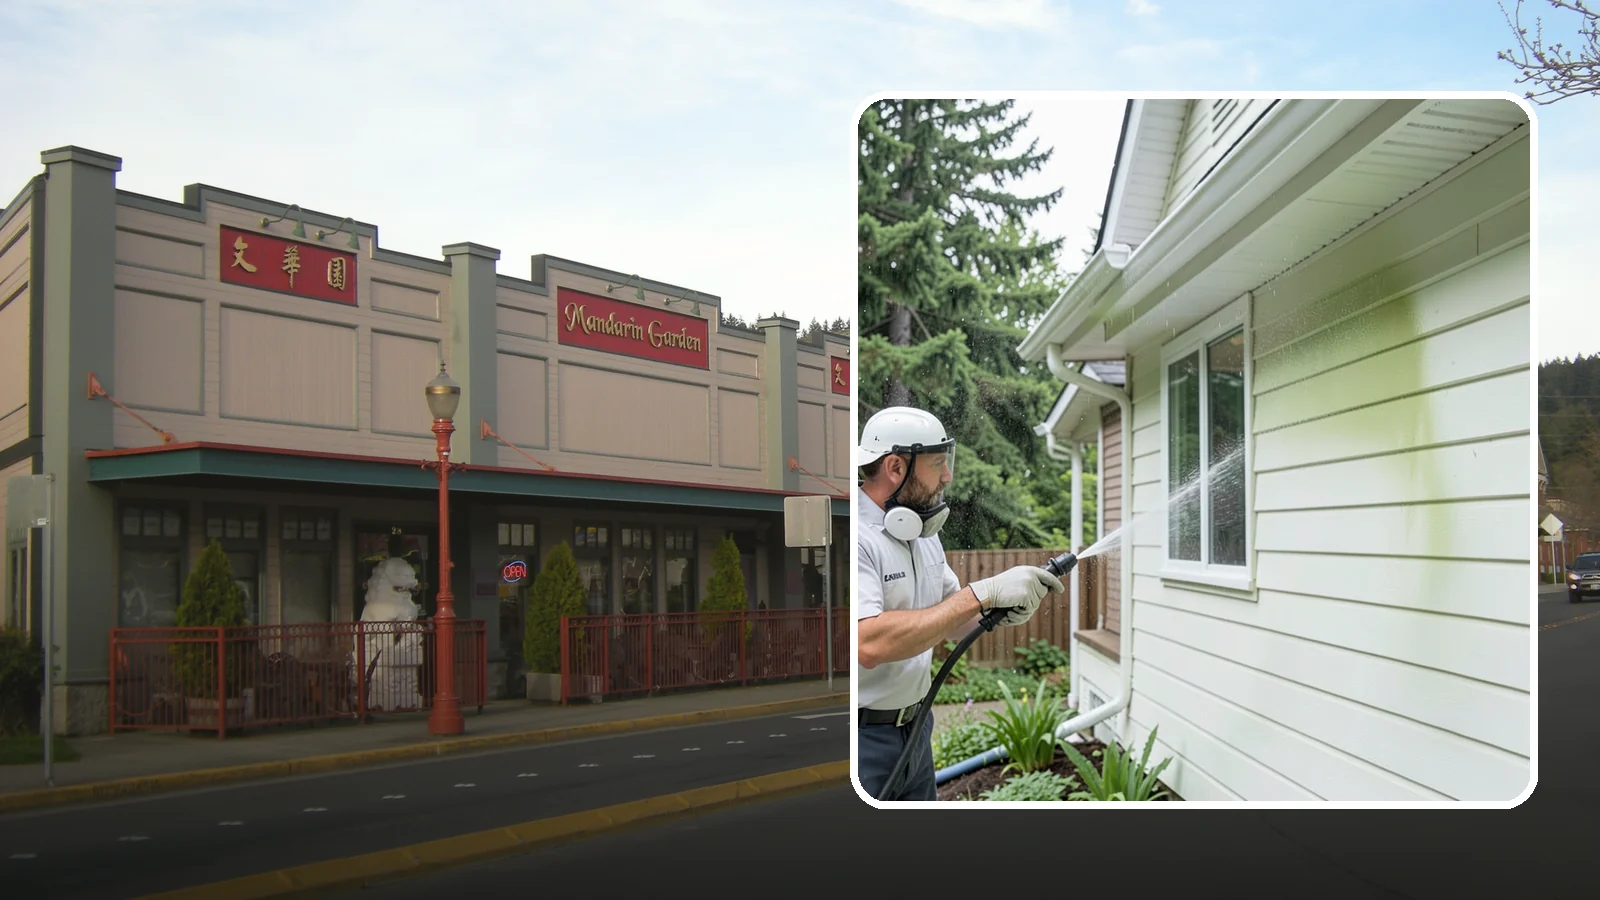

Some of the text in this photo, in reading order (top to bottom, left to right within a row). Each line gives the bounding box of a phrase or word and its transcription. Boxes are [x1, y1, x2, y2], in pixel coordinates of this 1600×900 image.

[230, 235, 346, 291] 文華園
[564, 302, 701, 352] Mandarin Garden
[503, 565, 526, 578] OPEN
